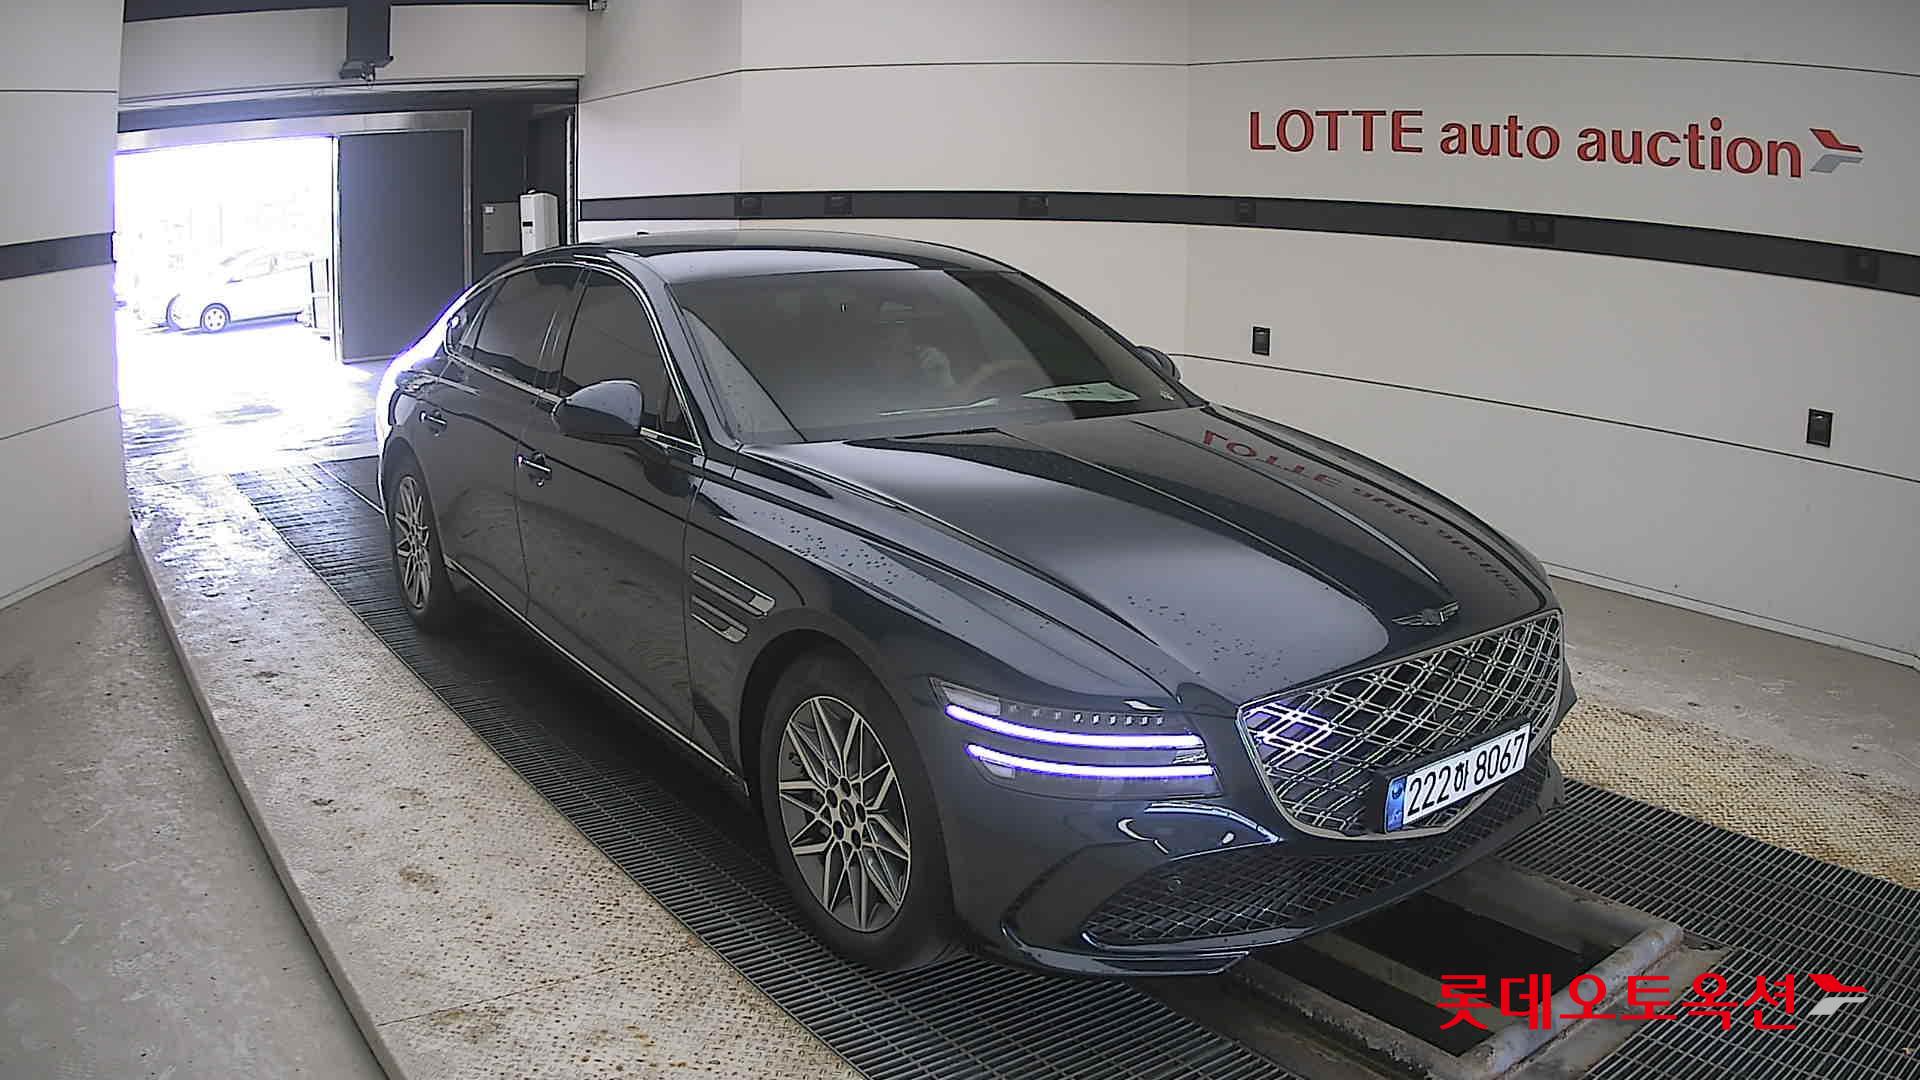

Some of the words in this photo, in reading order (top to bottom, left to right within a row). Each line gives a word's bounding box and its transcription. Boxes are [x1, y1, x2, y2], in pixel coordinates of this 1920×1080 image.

[1250, 110, 1423, 152] LOTTE
[1440, 115, 1560, 160] auto
[1577, 117, 1802, 178] auction
